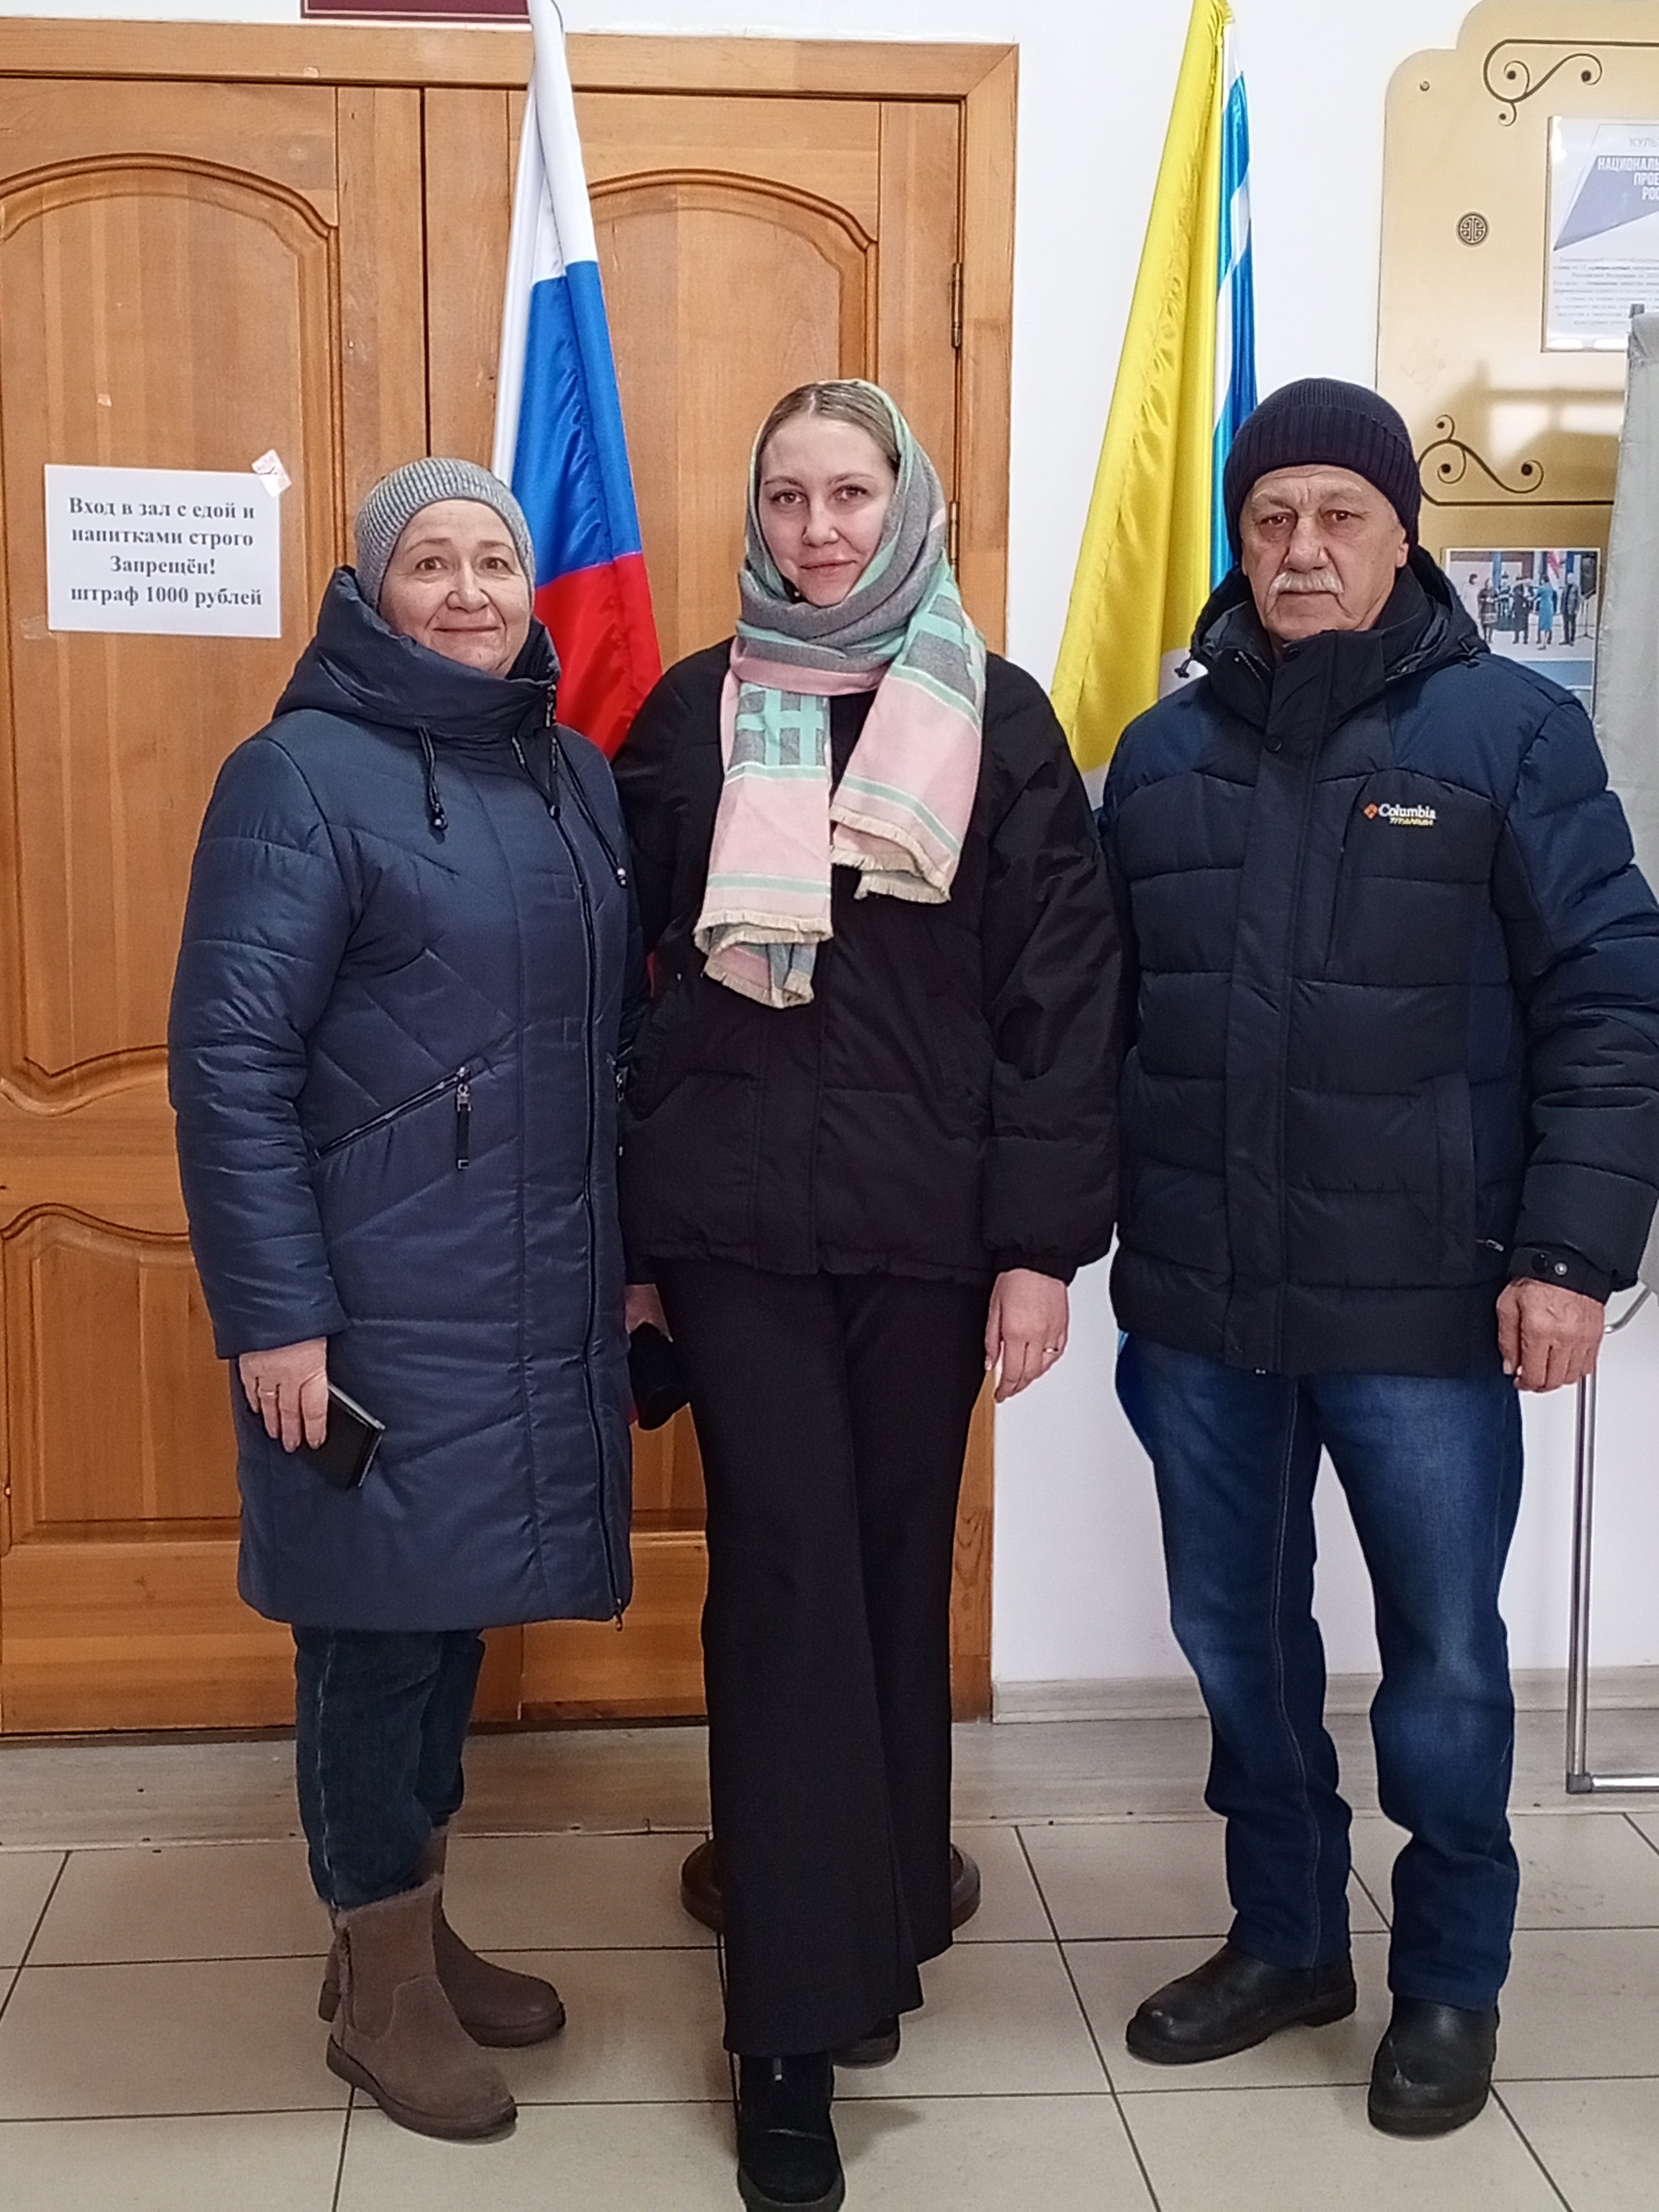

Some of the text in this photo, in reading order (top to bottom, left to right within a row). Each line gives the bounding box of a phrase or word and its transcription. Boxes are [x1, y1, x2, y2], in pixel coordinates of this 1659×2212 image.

[1629, 138, 1659, 147] КУЛЬ
[69, 497, 255, 519] Вход в зал с едой и
[72, 529, 254, 550] напитками строго
[110, 555, 216, 578] Запрещён!
[71, 585, 262, 609] штраф 1000 рублей
[1378, 803, 1436, 819] Columbia
